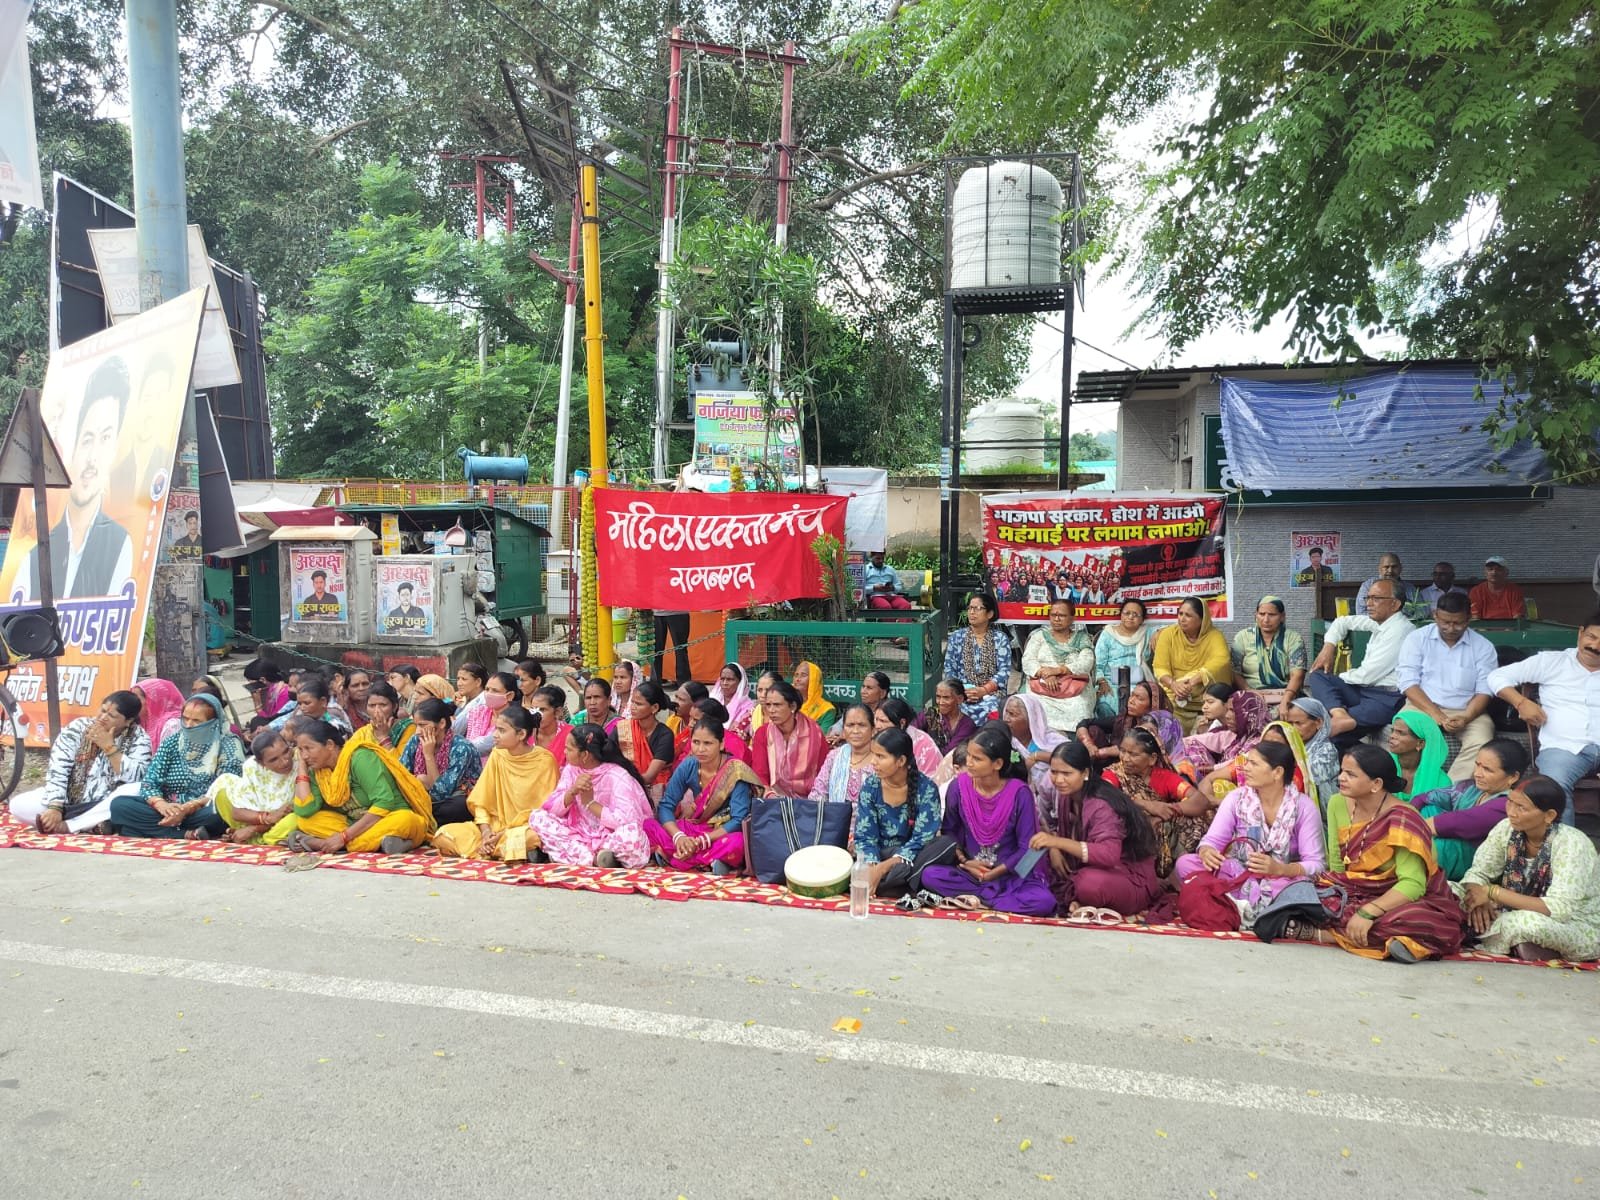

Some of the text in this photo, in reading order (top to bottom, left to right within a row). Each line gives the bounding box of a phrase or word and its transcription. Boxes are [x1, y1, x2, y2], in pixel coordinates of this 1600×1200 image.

[994, 503, 1204, 525] भाजपा सरकार, होश में आओ
[606, 501, 837, 551] महिला एकता मंच
[998, 519, 1211, 546] महंगाई पर लगाम लगाओ!
[1295, 535, 1337, 550] अध्यक्ष
[296, 553, 342, 574] अध्यक्ष
[383, 567, 429, 587] अध्यक्ष
[669, 562, 755, 593] रामनगर
[1089, 606, 1121, 616] एक
[41, 666, 99, 706] ध्यक्ष
[824, 684, 856, 698] स्वच्छ
